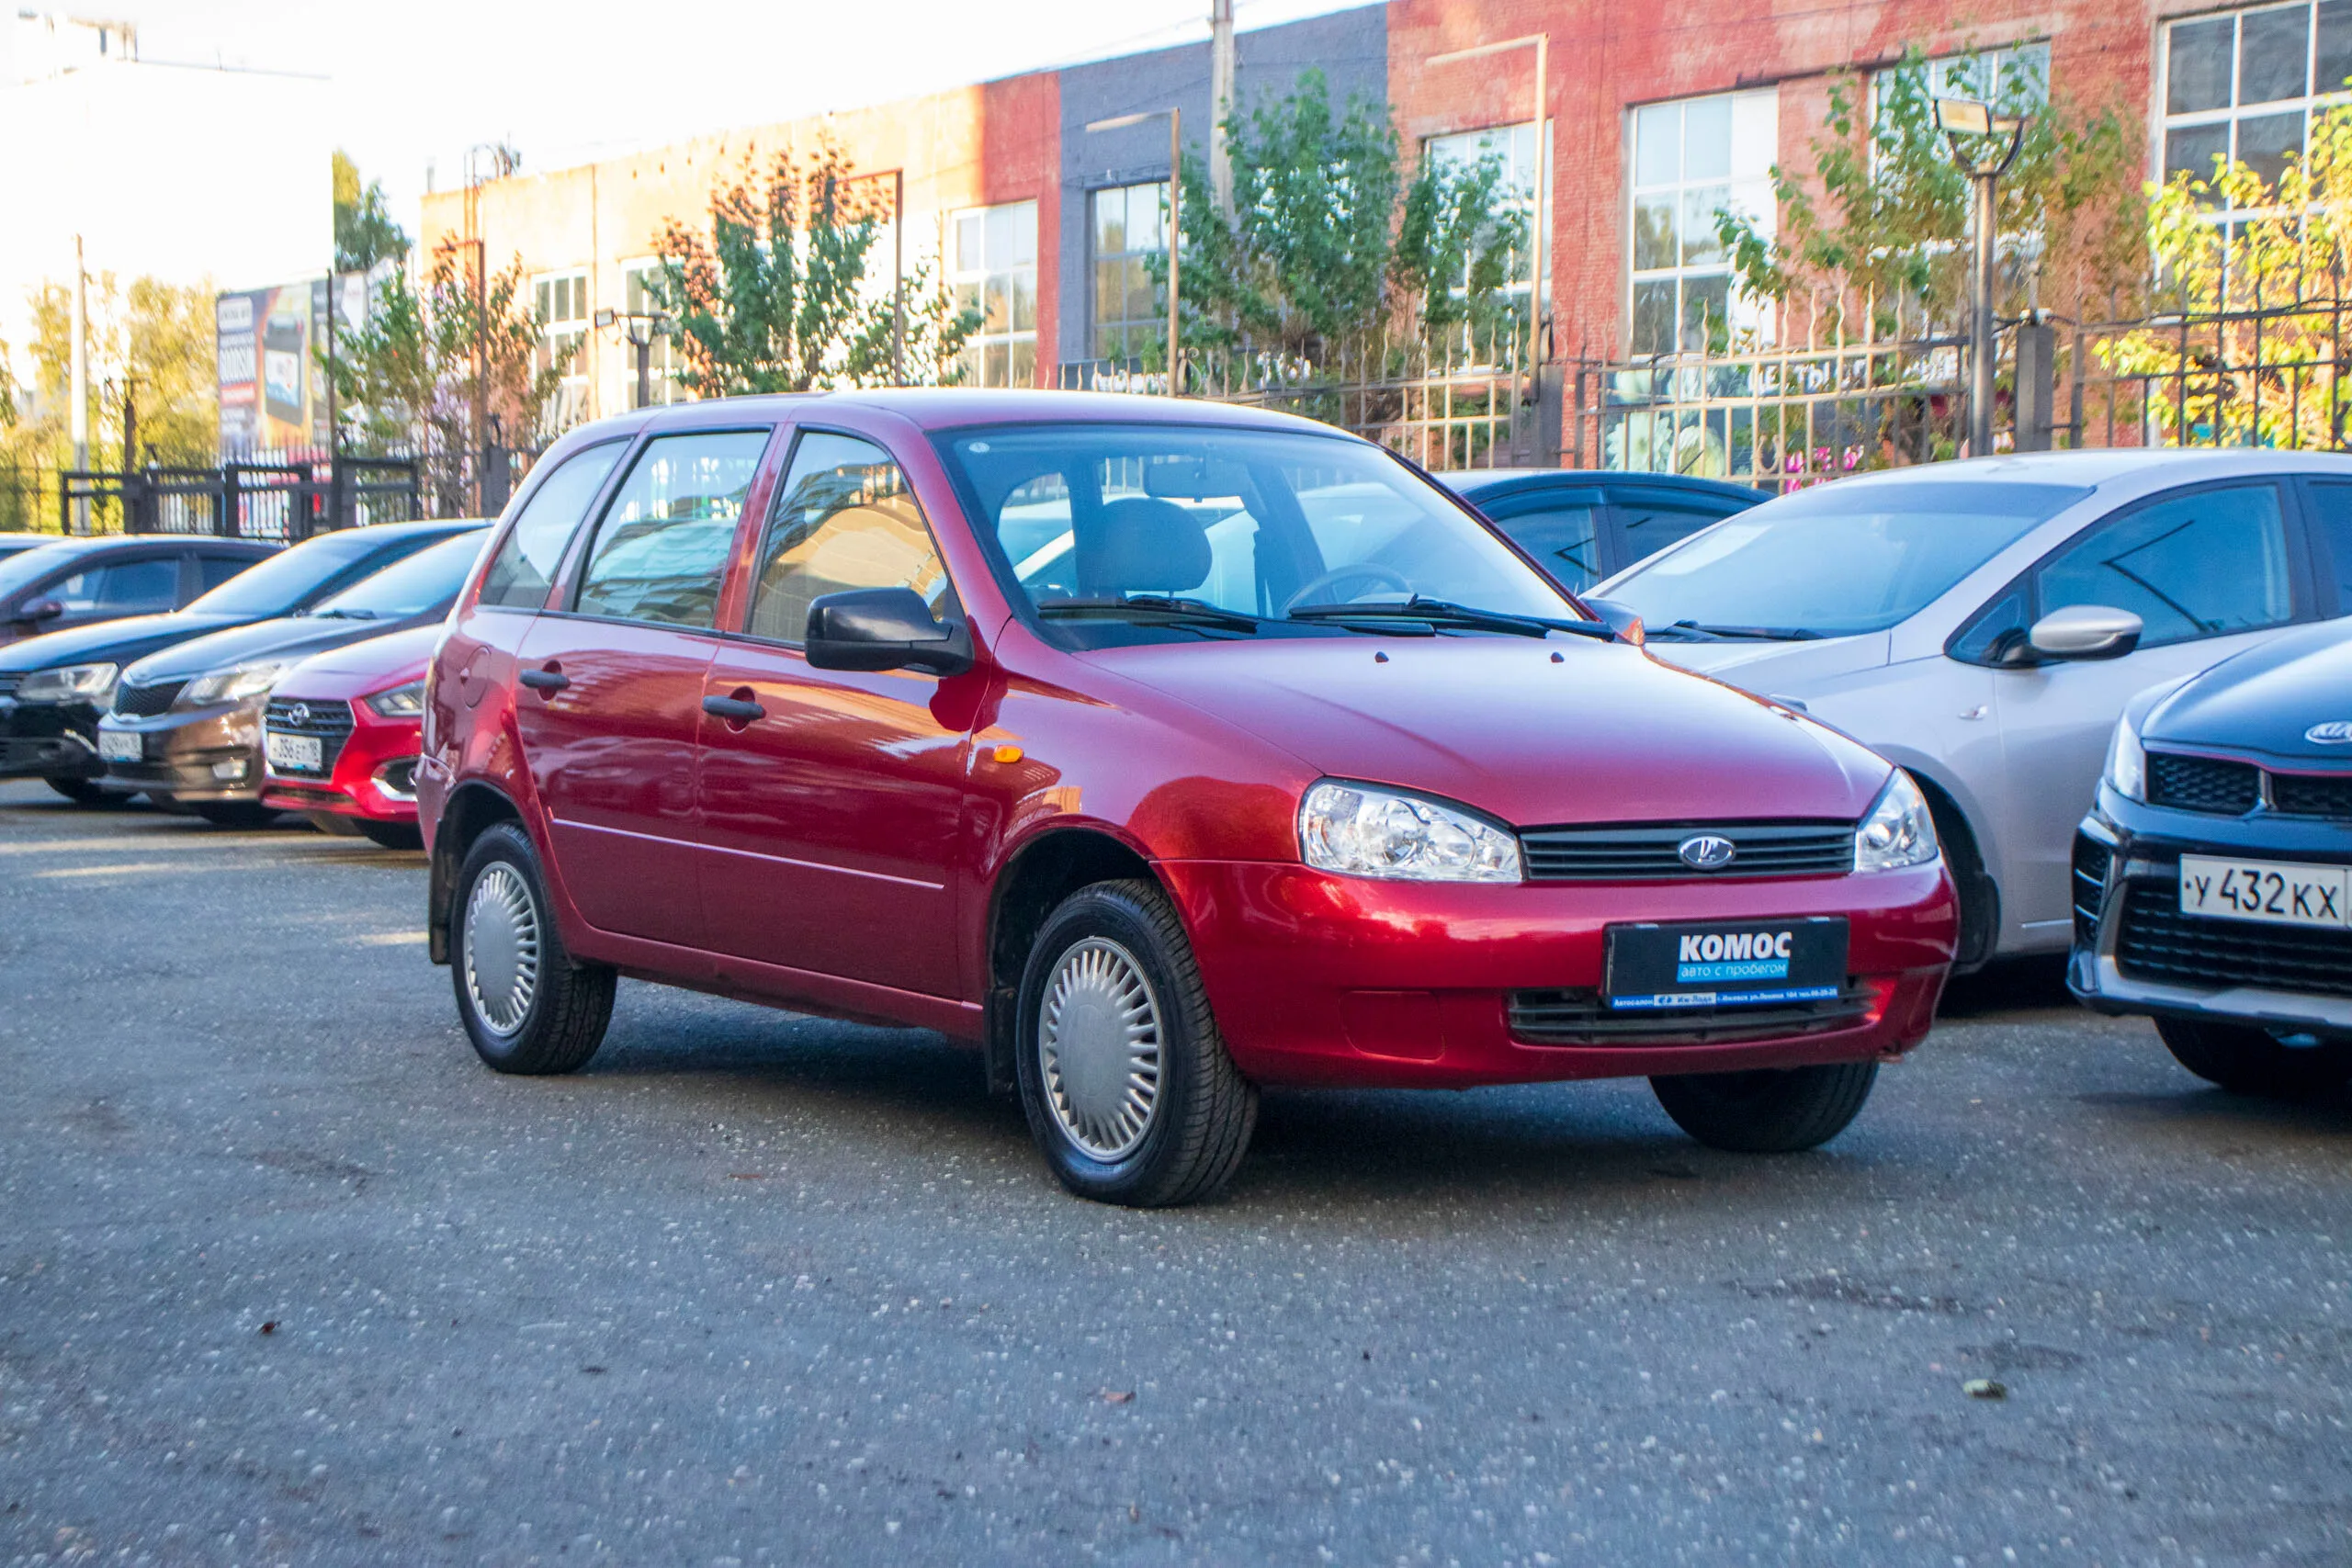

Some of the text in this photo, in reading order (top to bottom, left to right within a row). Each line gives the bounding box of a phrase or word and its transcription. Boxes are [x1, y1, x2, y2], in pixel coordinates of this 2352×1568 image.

[1679, 931, 1792, 962] КОМОС
[1681, 963, 1787, 978] авто с пробегом
